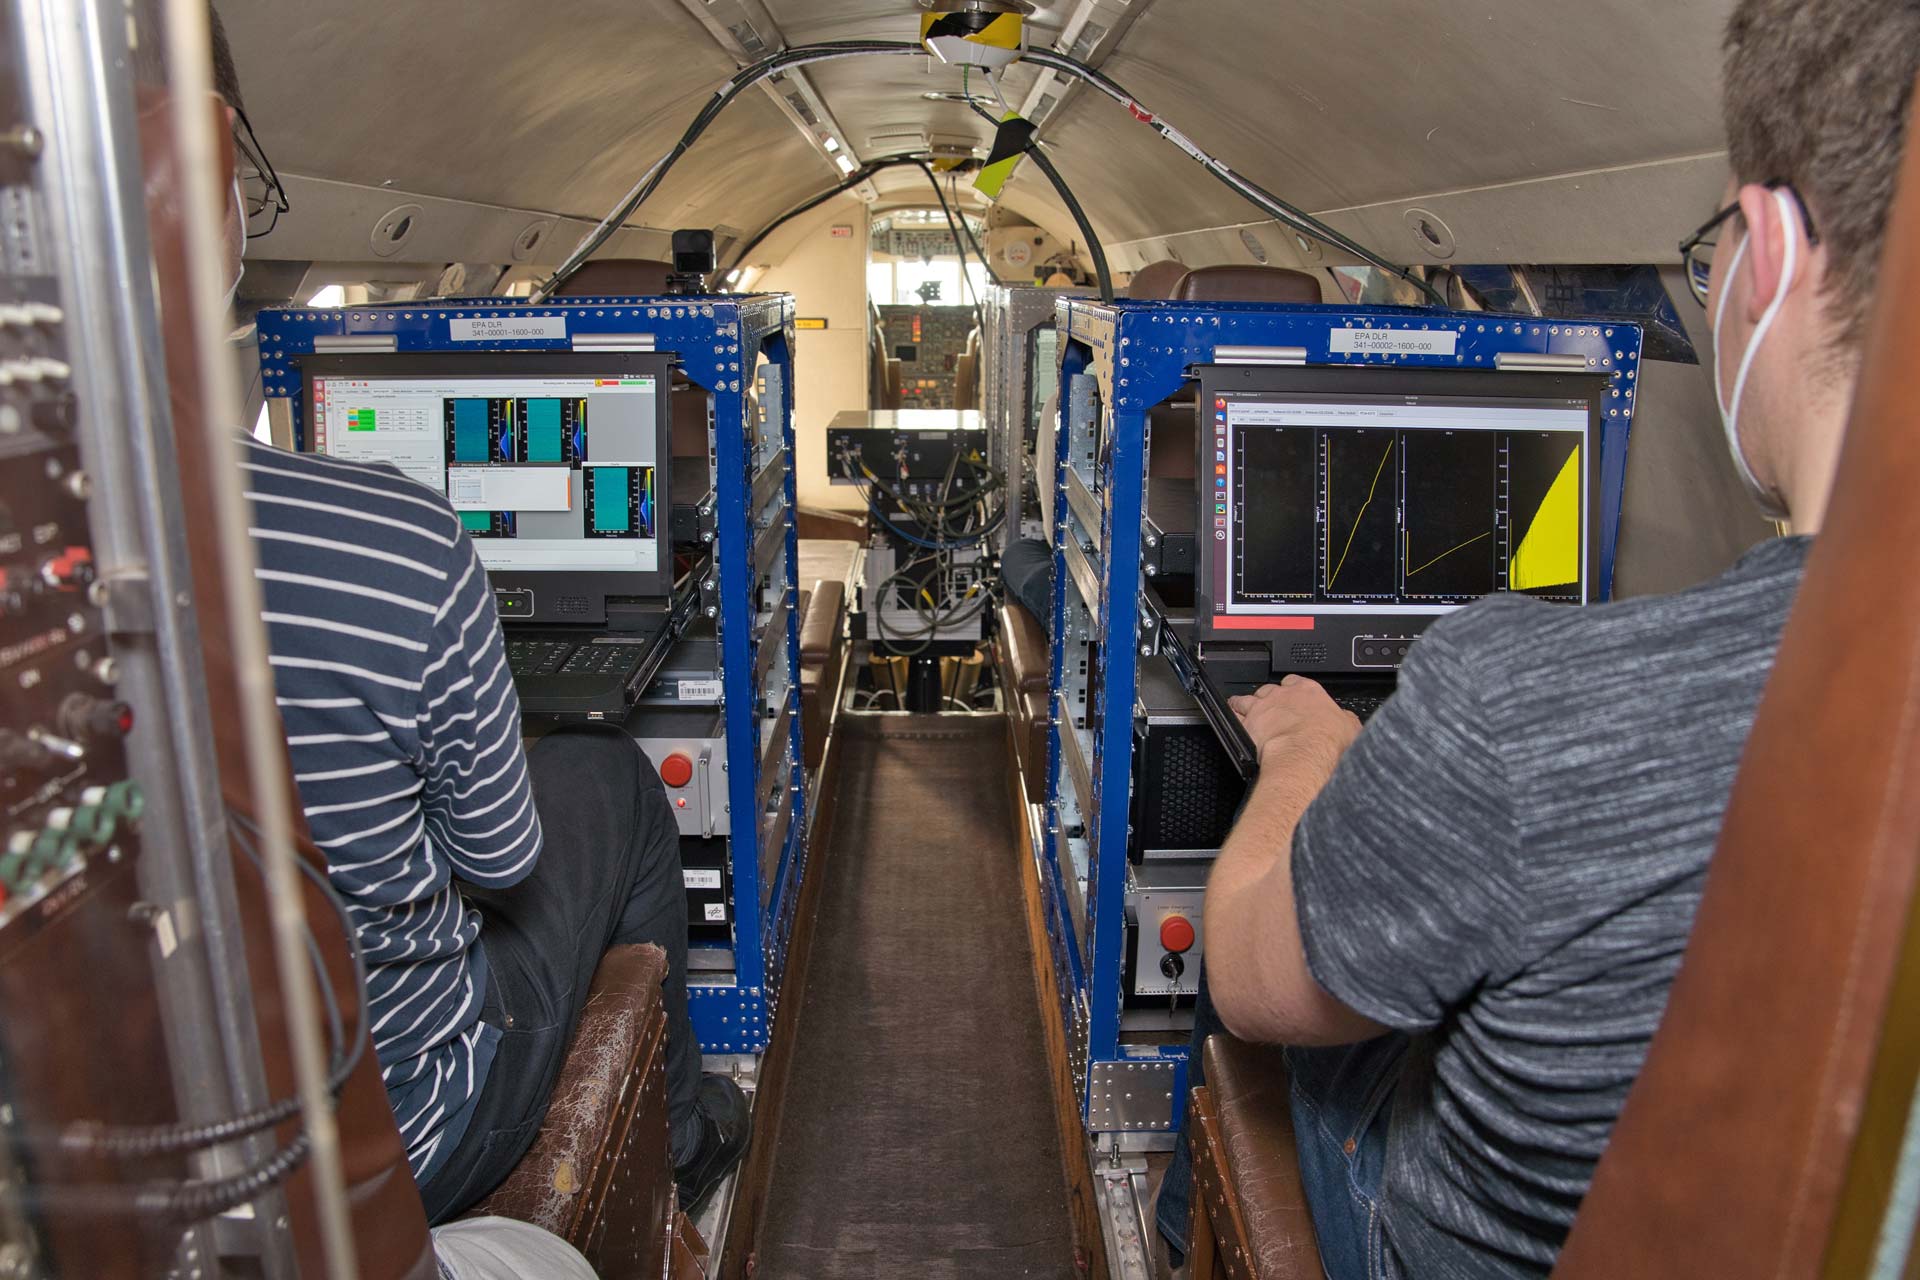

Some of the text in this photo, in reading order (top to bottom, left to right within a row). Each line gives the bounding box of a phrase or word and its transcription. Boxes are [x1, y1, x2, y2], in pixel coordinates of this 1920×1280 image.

[472, 329, 544, 337] 341-00001-1600-000
[1354, 332, 1388, 340] EPA DLR
[1354, 342, 1431, 350] 341-00002-1600-000
